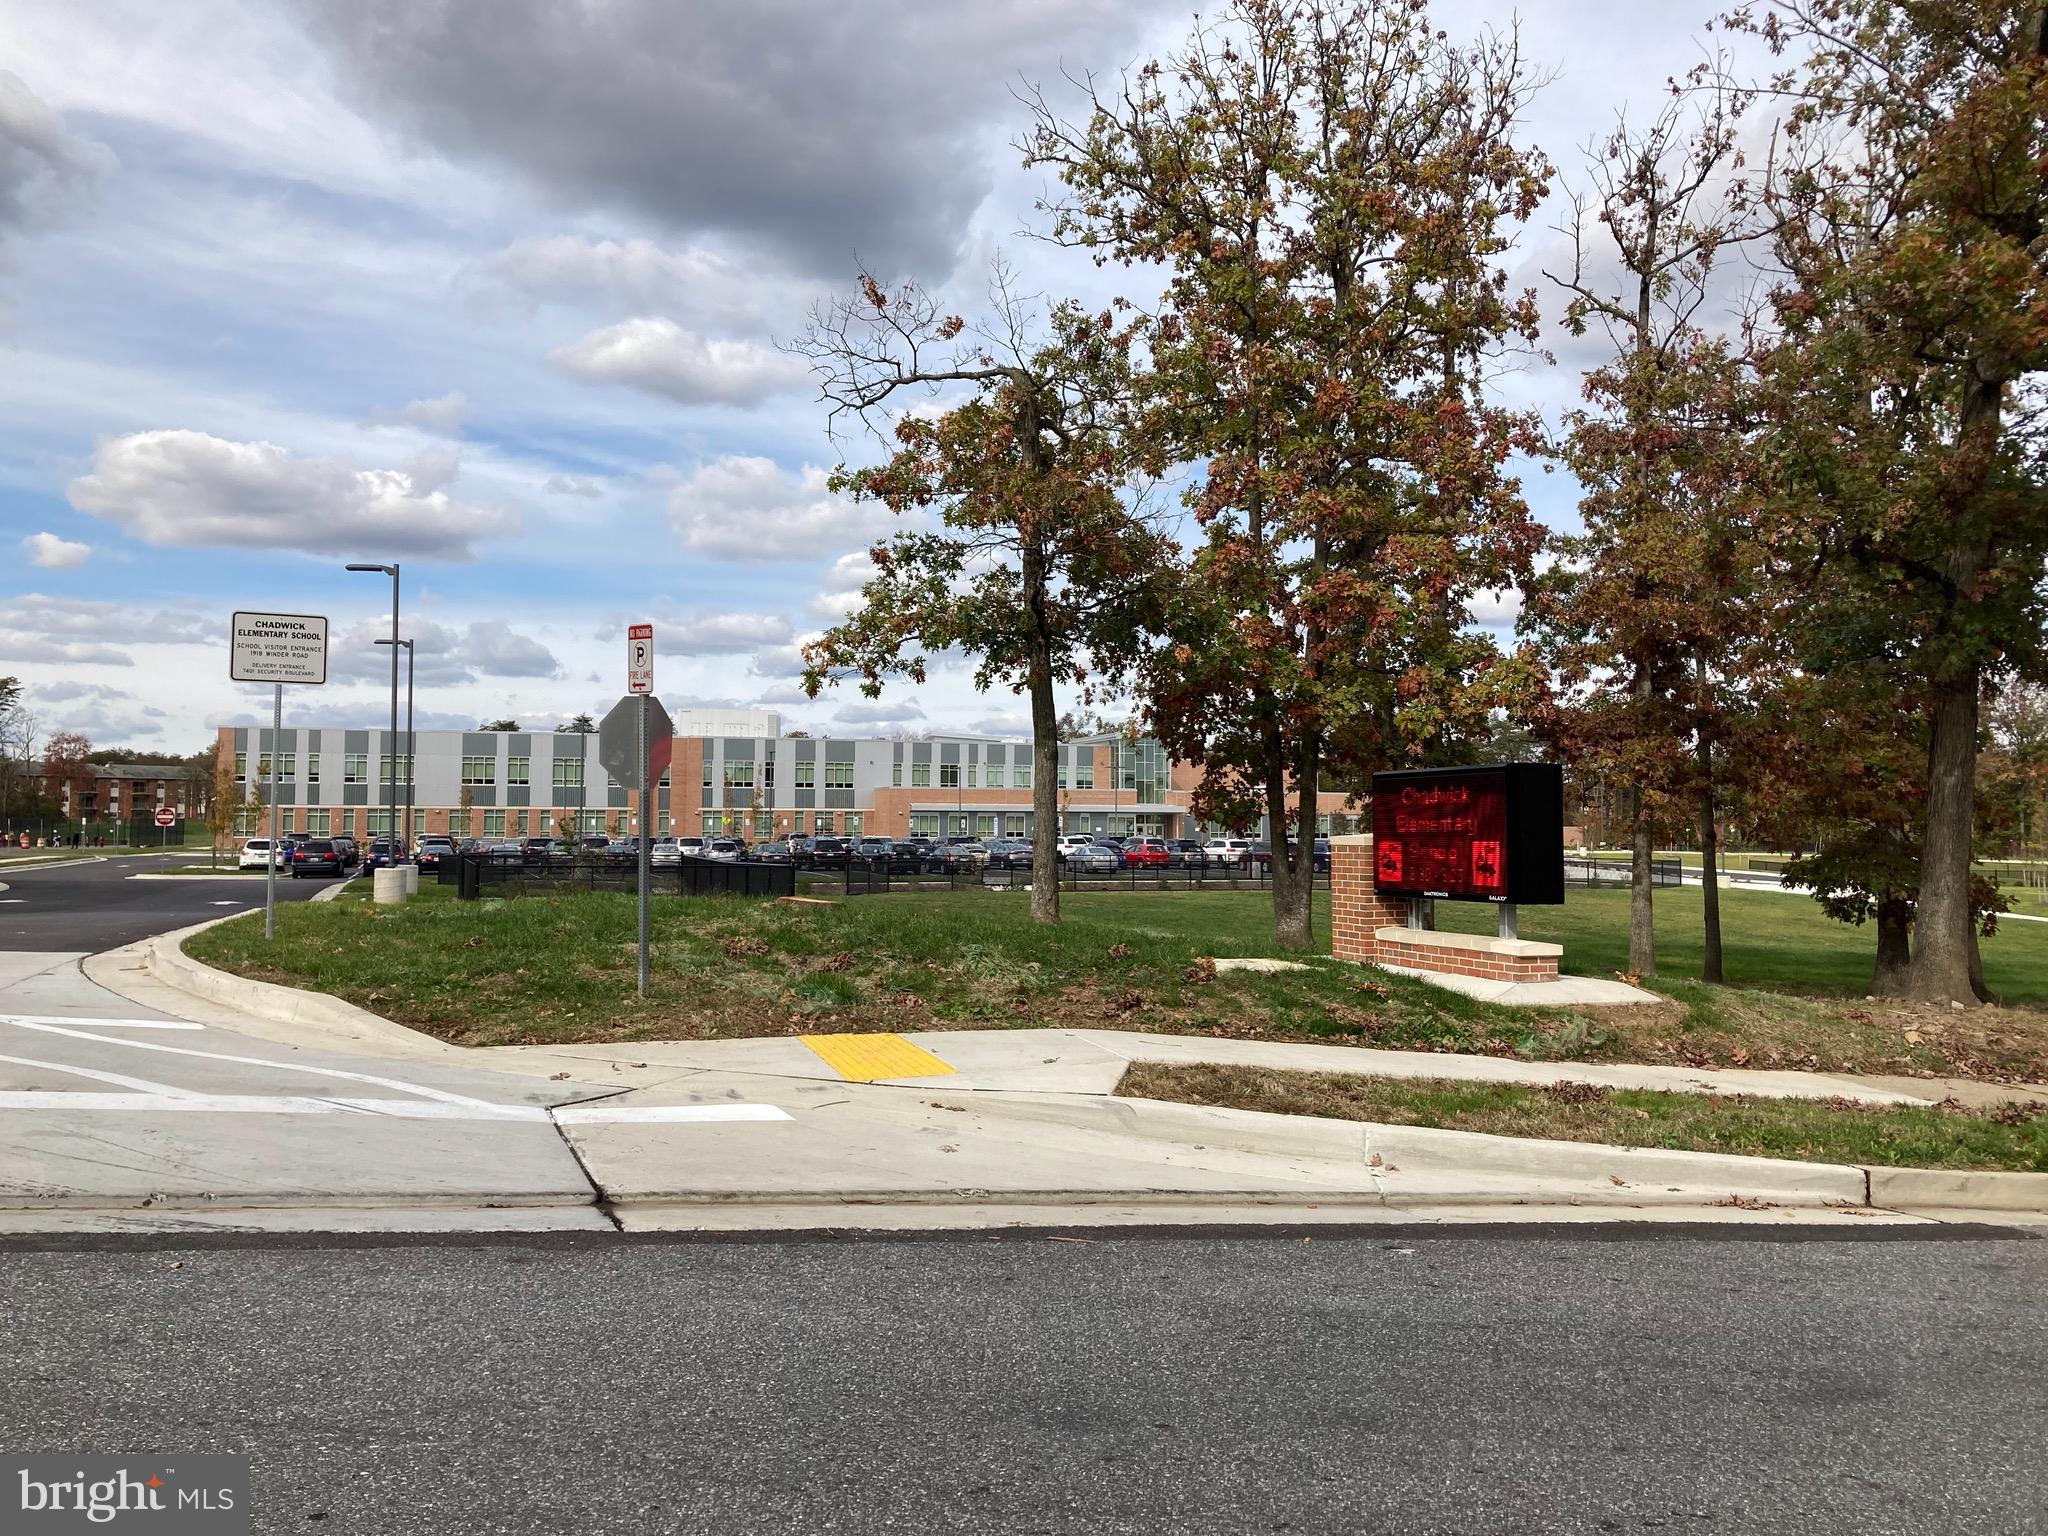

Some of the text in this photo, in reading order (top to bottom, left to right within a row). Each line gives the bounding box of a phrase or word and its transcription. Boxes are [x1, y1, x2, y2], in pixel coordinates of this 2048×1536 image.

[255, 620, 306, 630] CHADWICK
[238, 629, 321, 640] ELEMENTARY SCHOOL
[1401, 786, 1469, 805] Chadwick
[1396, 815, 1478, 836] Elementary
